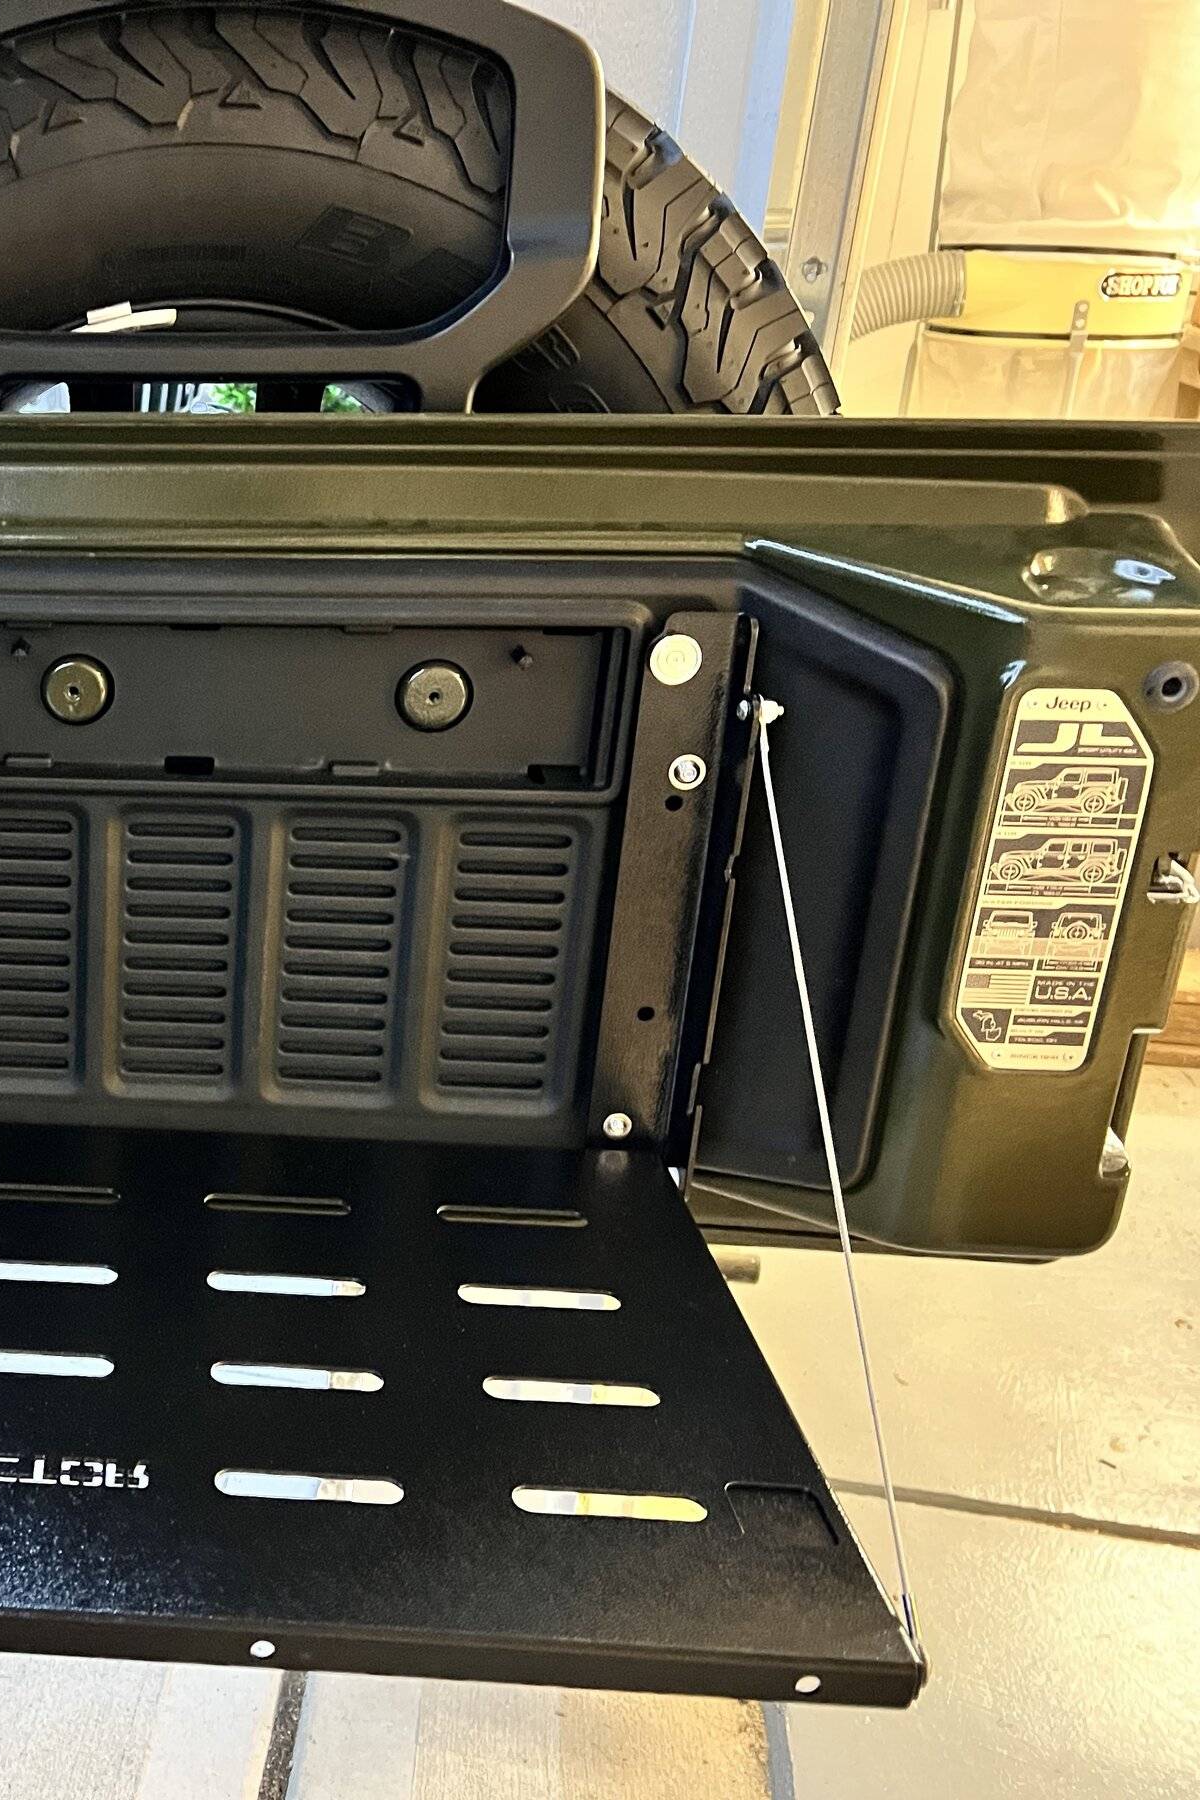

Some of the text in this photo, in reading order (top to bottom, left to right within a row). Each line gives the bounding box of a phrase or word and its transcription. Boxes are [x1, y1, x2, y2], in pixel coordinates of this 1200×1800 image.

[1105, 274, 1153, 296] SHOP
[1046, 696, 1091, 712] Jeep
[1016, 722, 1134, 753] JL
[1034, 985, 1092, 1001] U.S.A.
